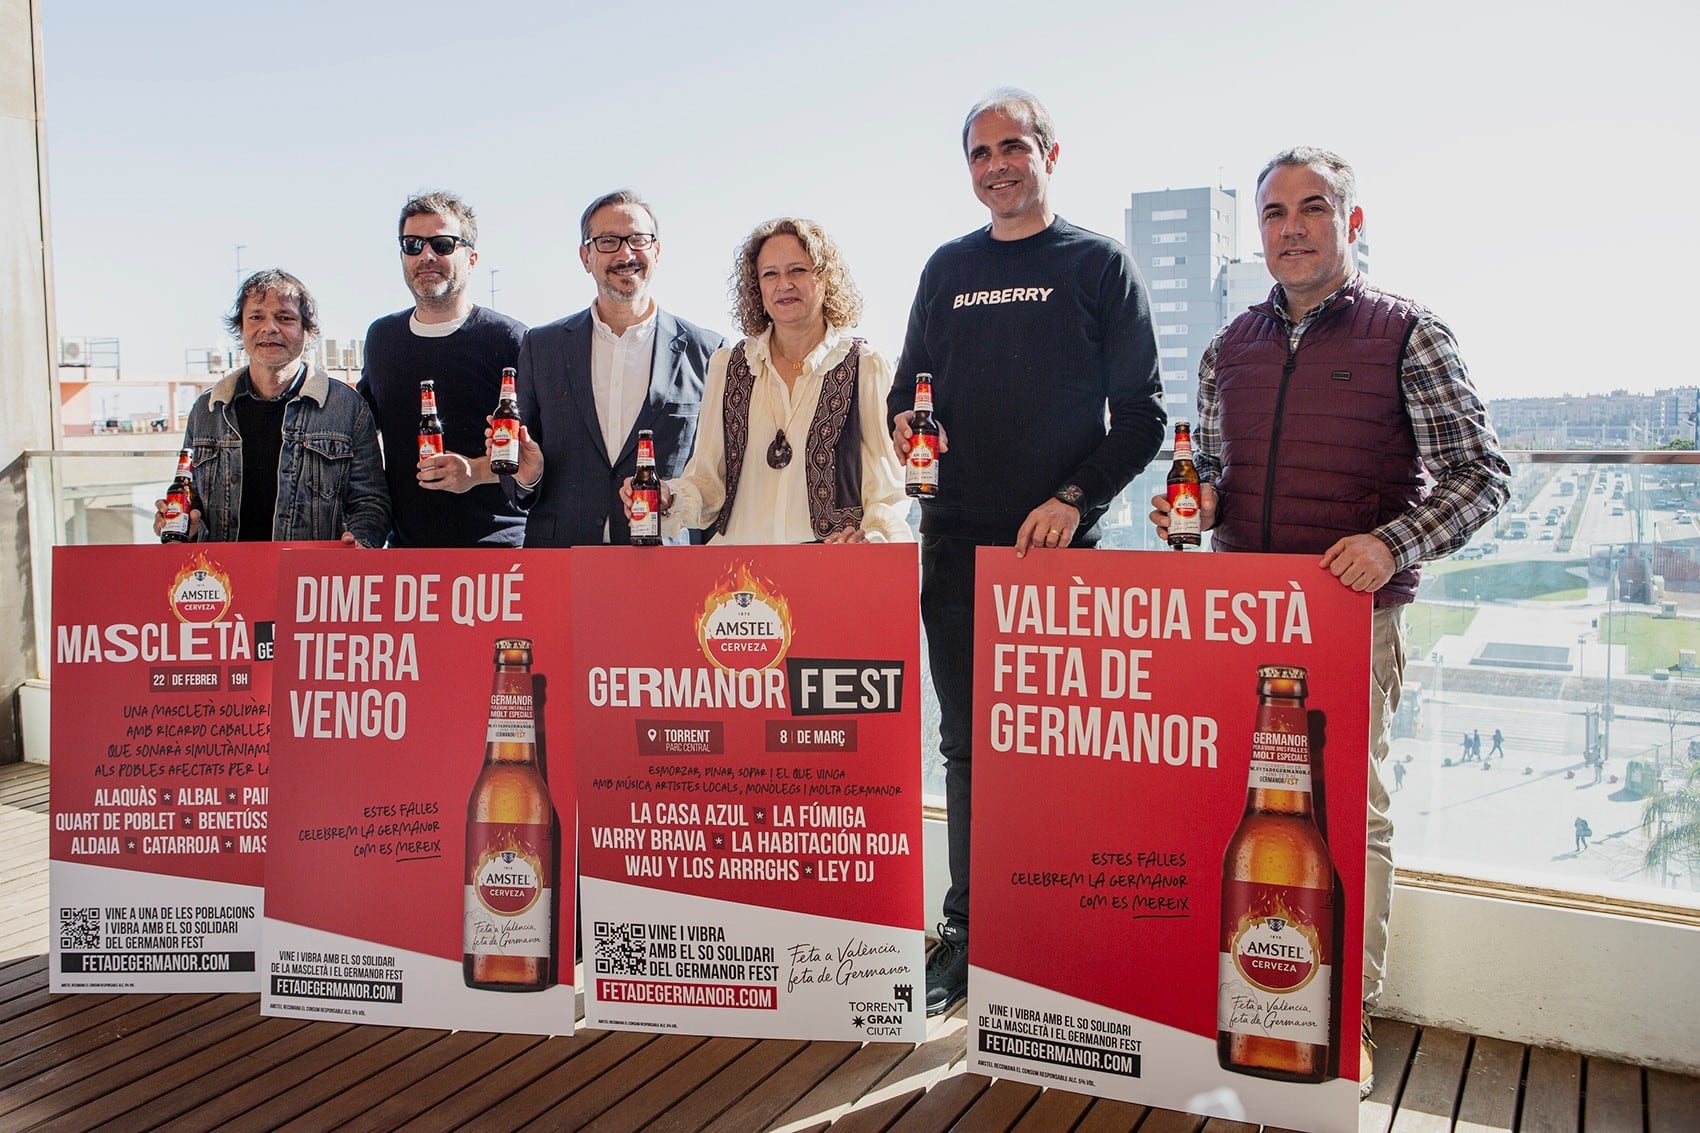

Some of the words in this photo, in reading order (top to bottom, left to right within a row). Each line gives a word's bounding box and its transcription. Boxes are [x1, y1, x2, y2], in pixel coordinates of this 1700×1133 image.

[953, 288, 1053, 308] BURBERRY
[181, 590, 219, 600] AMSTEL
[296, 575, 383, 622] DIME
[394, 574, 440, 621] DE
[452, 564, 523, 626] QUÉ
[993, 576, 1192, 640] VALÈNCIA
[1205, 581, 1312, 644] ESTÀ
[716, 622, 774, 635] AMSTEL
[57, 614, 250, 663] MASCLETÀ
[721, 643, 767, 651] CERVEZA
[294, 633, 419, 682] TIERRA
[153, 674, 164, 685] 22
[172, 674, 183, 685] DE
[185, 674, 217, 685] FEBRER
[232, 673, 247, 684] 19H
[994, 644, 1087, 696] FETA
[1101, 649, 1152, 700] DE
[589, 667, 785, 708] GERMANOR
[801, 668, 900, 708] FEST
[124, 705, 148, 718] UNA
[151, 699, 215, 718] MASCLETÀ
[290, 689, 406, 740] VENGO
[126, 725, 152, 738] AMB
[157, 724, 206, 737] RICARDO
[664, 729, 710, 742] TORRENT
[780, 730, 787, 743] 8
[797, 730, 810, 743] DE
[814, 730, 844, 746] MARÇ
[991, 703, 1217, 768] GERMANOR
[1253, 732, 1307, 746] GERMANOR
[108, 744, 131, 758] QUE
[136, 741, 181, 757] SONARÀ
[666, 743, 682, 751] PARC
[683, 743, 710, 752] CENTRAL
[1253, 751, 1274, 759] MOLT
[1277, 752, 1307, 761] ESPECIALS
[95, 764, 114, 777] ALS
[118, 763, 164, 777] POBLES
[168, 763, 224, 777] AFECTATS
[228, 762, 254, 776] PER
[738, 767, 766, 778] SOPAR
[776, 768, 789, 778] EL
[793, 768, 812, 779] QUE
[816, 769, 845, 779] VINGA
[95, 785, 156, 806] ALAQUÀS
[178, 788, 221, 805] ALBAL
[593, 779, 613, 789] AMB
[655, 781, 699, 792] ARTISTES
[745, 779, 800, 794] MONÒLEGS
[809, 785, 841, 795] MOLTA
[844, 784, 902, 796] GERMANOR
[363, 804, 396, 818] ESTES
[399, 802, 438, 816] FALLES
[631, 802, 651, 823] LA
[656, 803, 700, 824] CASA
[705, 804, 748, 826] AZUL
[773, 805, 794, 826] LA
[800, 802, 866, 828] FÚMIGA
[56, 813, 100, 831] QUART
[103, 813, 120, 830] DE
[124, 812, 175, 830] POBLET
[299, 825, 357, 841] CELEBREM
[361, 824, 374, 839] LA
[377, 821, 440, 836] GERMANOR
[71, 837, 120, 854] ALDAIA
[143, 836, 219, 854] CATARROJA
[353, 843, 376, 857] COM
[379, 843, 392, 855] ES
[395, 839, 440, 855] MEREIX
[591, 827, 646, 849] VARRY
[651, 829, 706, 851] BRAVA
[732, 831, 753, 852] LA
[758, 829, 860, 854] HABITACIÓN
[867, 833, 909, 854] ROJA
[1091, 852, 1132, 866] ESTES
[1137, 852, 1186, 866] FALLES
[625, 855, 662, 876] WAU
[667, 856, 678, 877] Y
[683, 857, 714, 878] LOS
[719, 858, 799, 880] ARRRGHS
[818, 860, 850, 881] LEY
[855, 861, 873, 882] DJ
[485, 873, 530, 885] AMSTEL
[1011, 872, 1084, 887] CELEBREM
[1089, 874, 1105, 888] LA
[1109, 874, 1188, 889] GERMANOR
[1080, 894, 1107, 909] COM
[1111, 896, 1128, 909] ES
[1132, 895, 1188, 910] MEREIX
[105, 907, 126, 919] VINE
[139, 907, 158, 919] UNA
[161, 907, 172, 919] DE
[176, 907, 192, 919] LES
[195, 906, 254, 919] POBLACIONS
[111, 922, 139, 934] VIBRA
[142, 922, 163, 934] AMB
[166, 922, 177, 934] EL
[180, 921, 192, 934] SO
[194, 921, 238, 934] SOLIDARI
[648, 924, 676, 940] VINE
[687, 926, 725, 942] VIBRA
[106, 937, 123, 948] DEL
[126, 936, 178, 949] GERMANOR
[181, 936, 204, 948] FEST
[1247, 942, 1304, 959] AMSTEL
[649, 943, 676, 958] AMB
[680, 944, 694, 959] EL
[698, 945, 713, 960] SO
[717, 945, 774, 962] SOLIDARI
[787, 944, 821, 966] Feta
[83, 954, 229, 970] FETADEGERMANOR.COM
[1252, 960, 1296, 972] CERVEZA
[650, 961, 672, 976] DEL
[676, 962, 744, 980] GERMANOR
[749, 965, 779, 981] FEST
[787, 968, 814, 993] feta
[817, 966, 832, 983] de
[836, 962, 910, 986] Germanor
[277, 979, 395, 1000] FETADEGERMANOR.COM
[603, 982, 772, 1007] FETADEGERMANOR.COM
[849, 1002, 904, 1012] TORRENT
[867, 1015, 902, 1024] GRAN
[988, 1004, 1008, 1018] VINE
[1015, 1008, 1040, 1022] VIBRA
[1043, 1012, 1062, 1026] AMB
[1065, 1016, 1075, 1027] EL
[1077, 1017, 1088, 1030] SO
[1090, 1019, 1130, 1036] SOLIDARI
[866, 1027, 902, 1035] CIUTAT
[979, 1016, 989, 1027] DE
[992, 1018, 1002, 1029] LA
[1004, 1020, 1048, 1037] MASCLETÀ
[1056, 1028, 1066, 1040] EL
[1068, 1030, 1117, 1048] GERMANOR
[1120, 1034, 1141, 1052] FEST
[986, 1034, 1133, 1073] FETADEGERMANOR.COM
